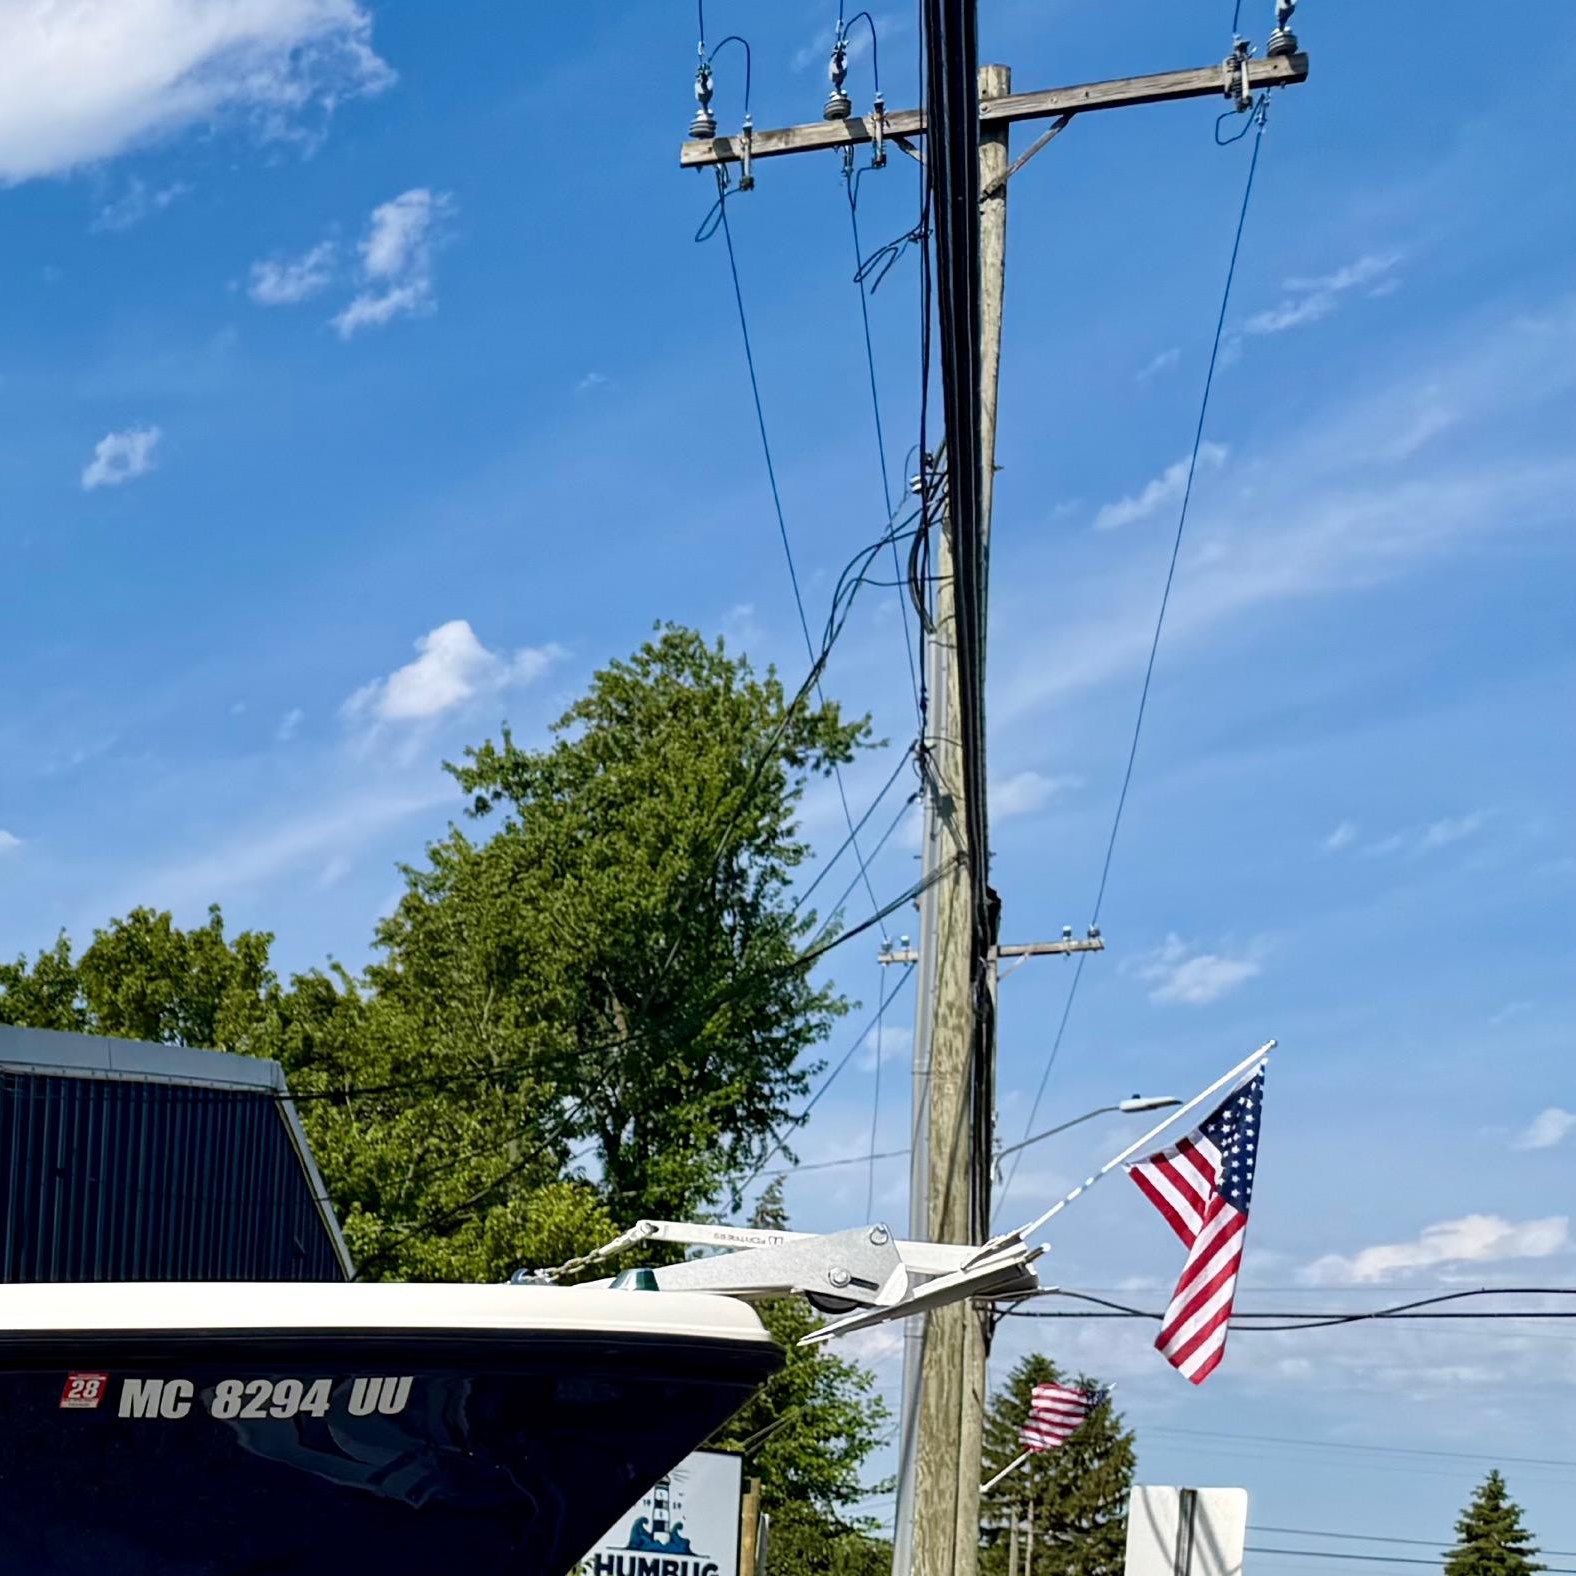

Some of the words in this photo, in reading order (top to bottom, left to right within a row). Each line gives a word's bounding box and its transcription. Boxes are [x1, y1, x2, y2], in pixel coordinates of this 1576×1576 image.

[67, 1379, 101, 1399] 28
[118, 1378, 195, 1419] MC
[210, 1378, 333, 1419] 8294
[347, 1375, 414, 1417] UU
